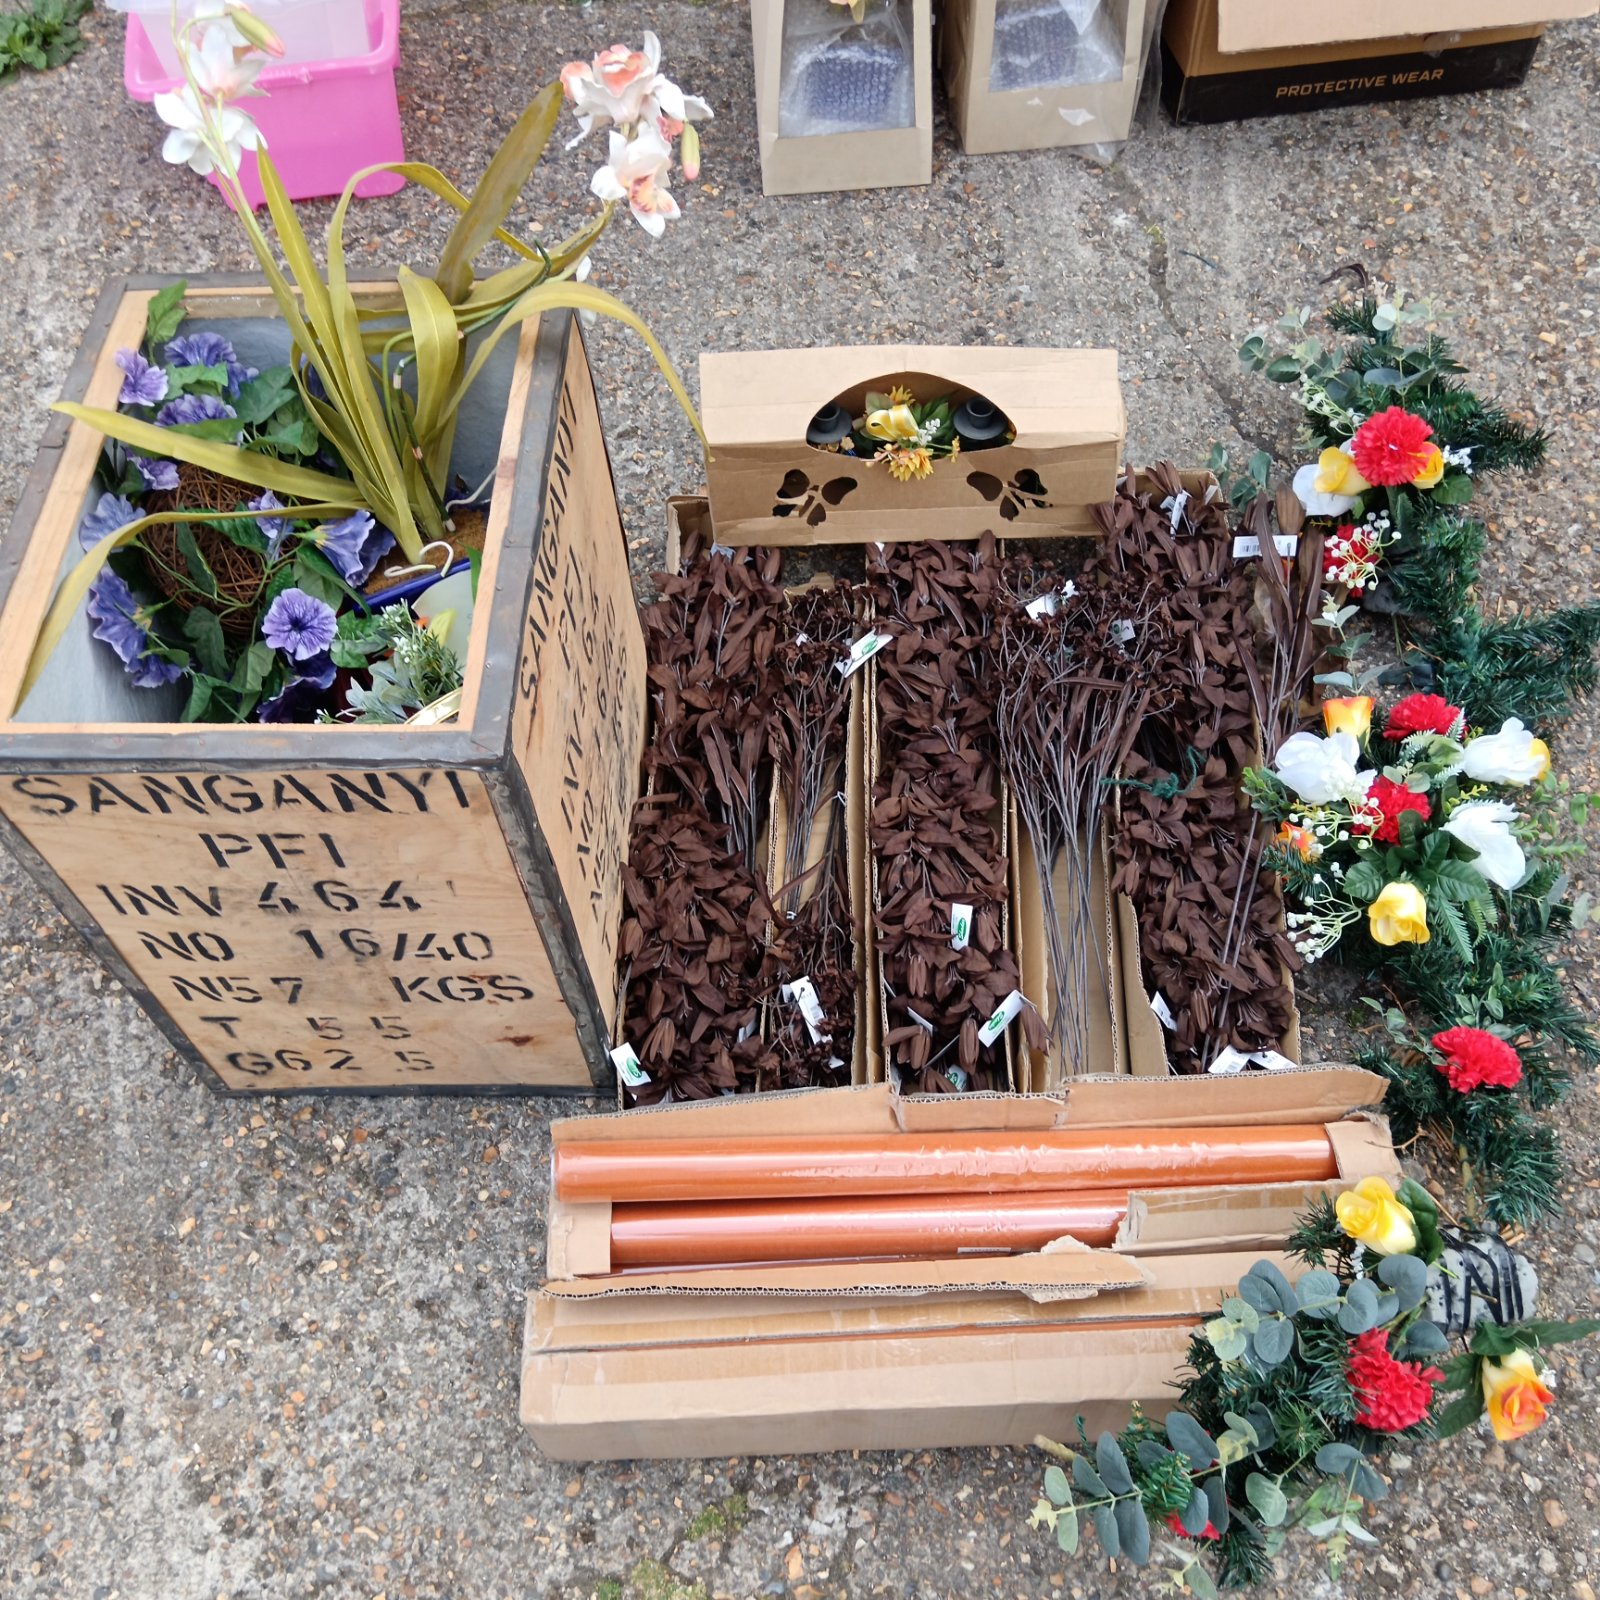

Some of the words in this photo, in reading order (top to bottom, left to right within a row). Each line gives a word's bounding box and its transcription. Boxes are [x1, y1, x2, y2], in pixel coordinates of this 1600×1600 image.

[1275, 75, 1387, 98] PROTECTIVE
[1391, 69, 1444, 85] WEAR
[12, 770, 471, 816] SANGANYI
[199, 832, 346, 868] PFI
[97, 883, 221, 917] INV
[258, 880, 422, 912] 464
[137, 930, 234, 962] NO
[295, 929, 494, 961] 16/40
[170, 975, 304, 1004] N57
[389, 975, 535, 1003] KGS
[199, 1015, 241, 1039] T
